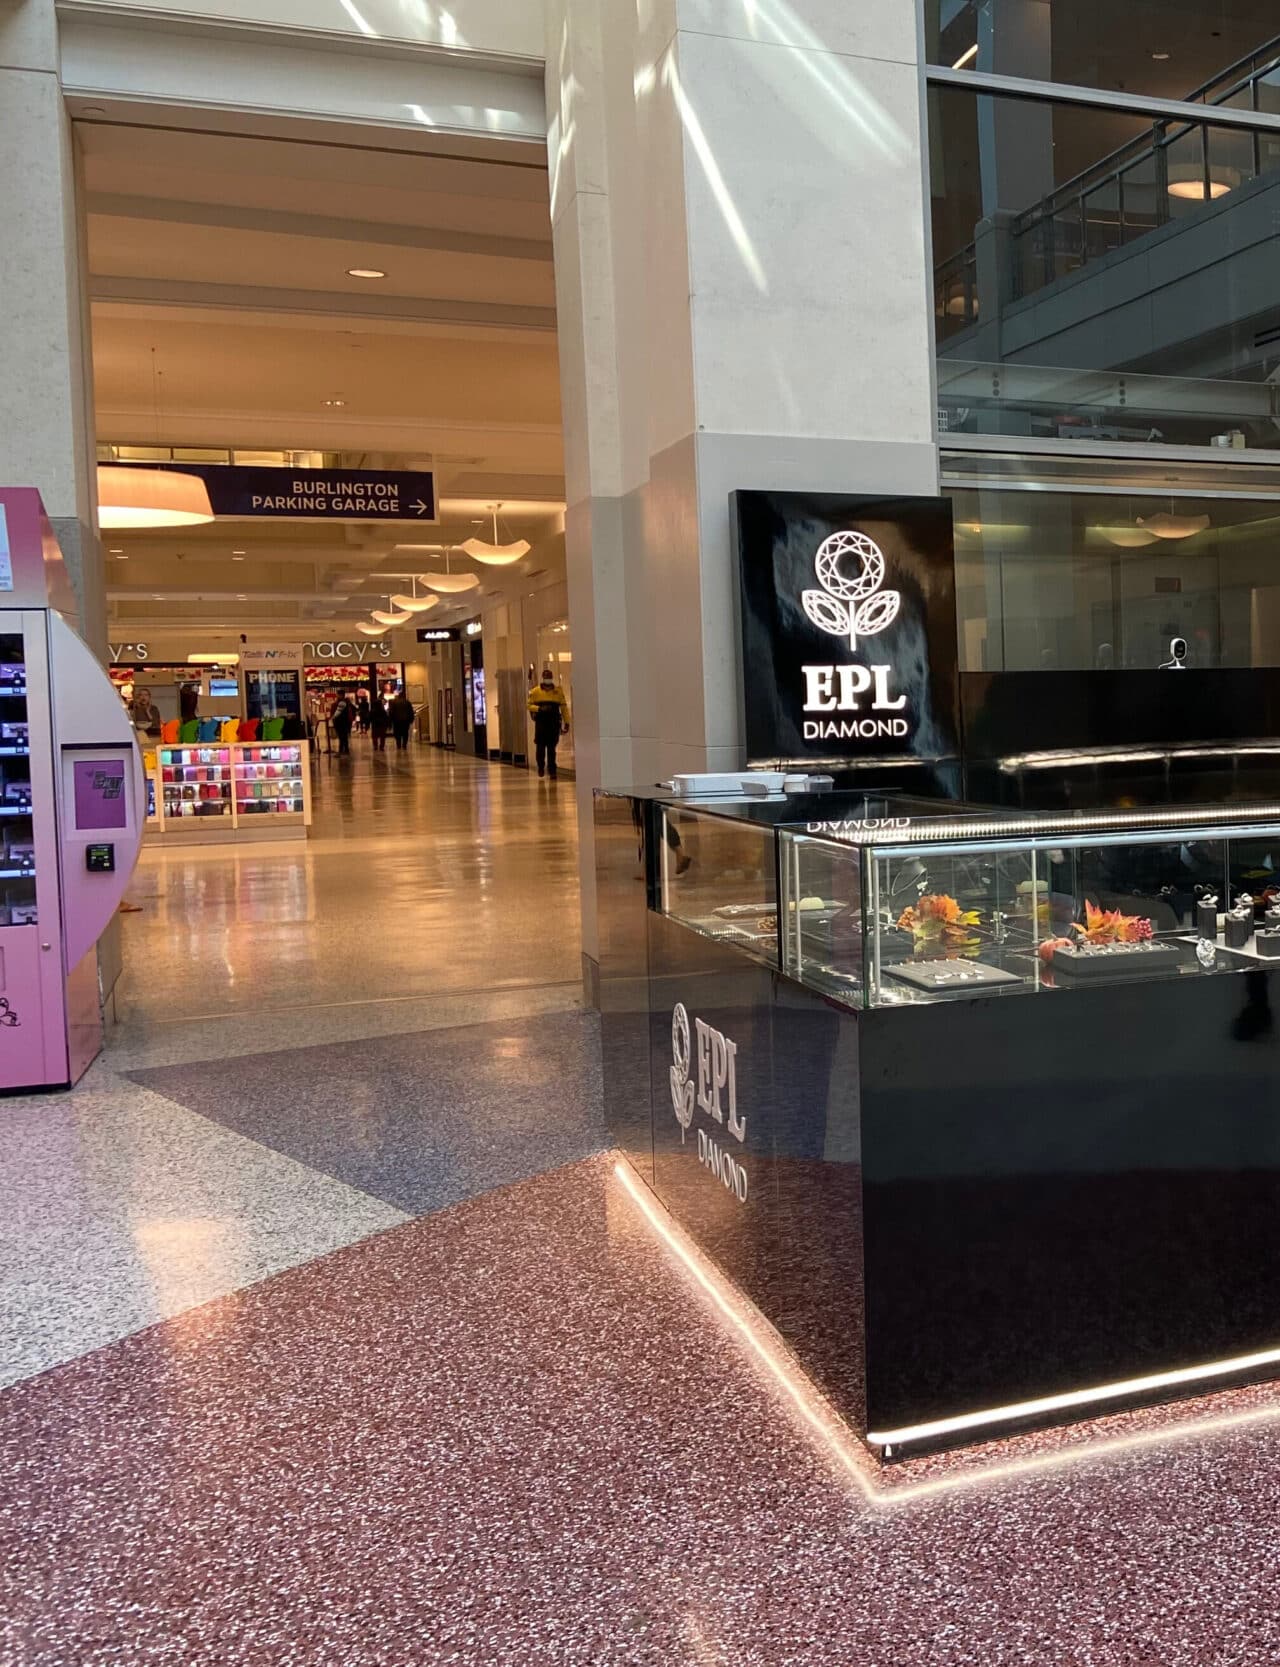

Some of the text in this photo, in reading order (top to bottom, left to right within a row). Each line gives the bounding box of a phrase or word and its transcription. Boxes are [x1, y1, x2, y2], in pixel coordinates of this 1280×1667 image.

[292, 481, 399, 497] BURLINGTON
[252, 495, 400, 512] PARKING GARAGE
[248, 671, 296, 684] PHONE
[801, 664, 907, 712] EPL
[803, 718, 908, 739] DIAMOND
[695, 1017, 746, 1143] EPL
[698, 1128, 748, 1203] DIAMOND
